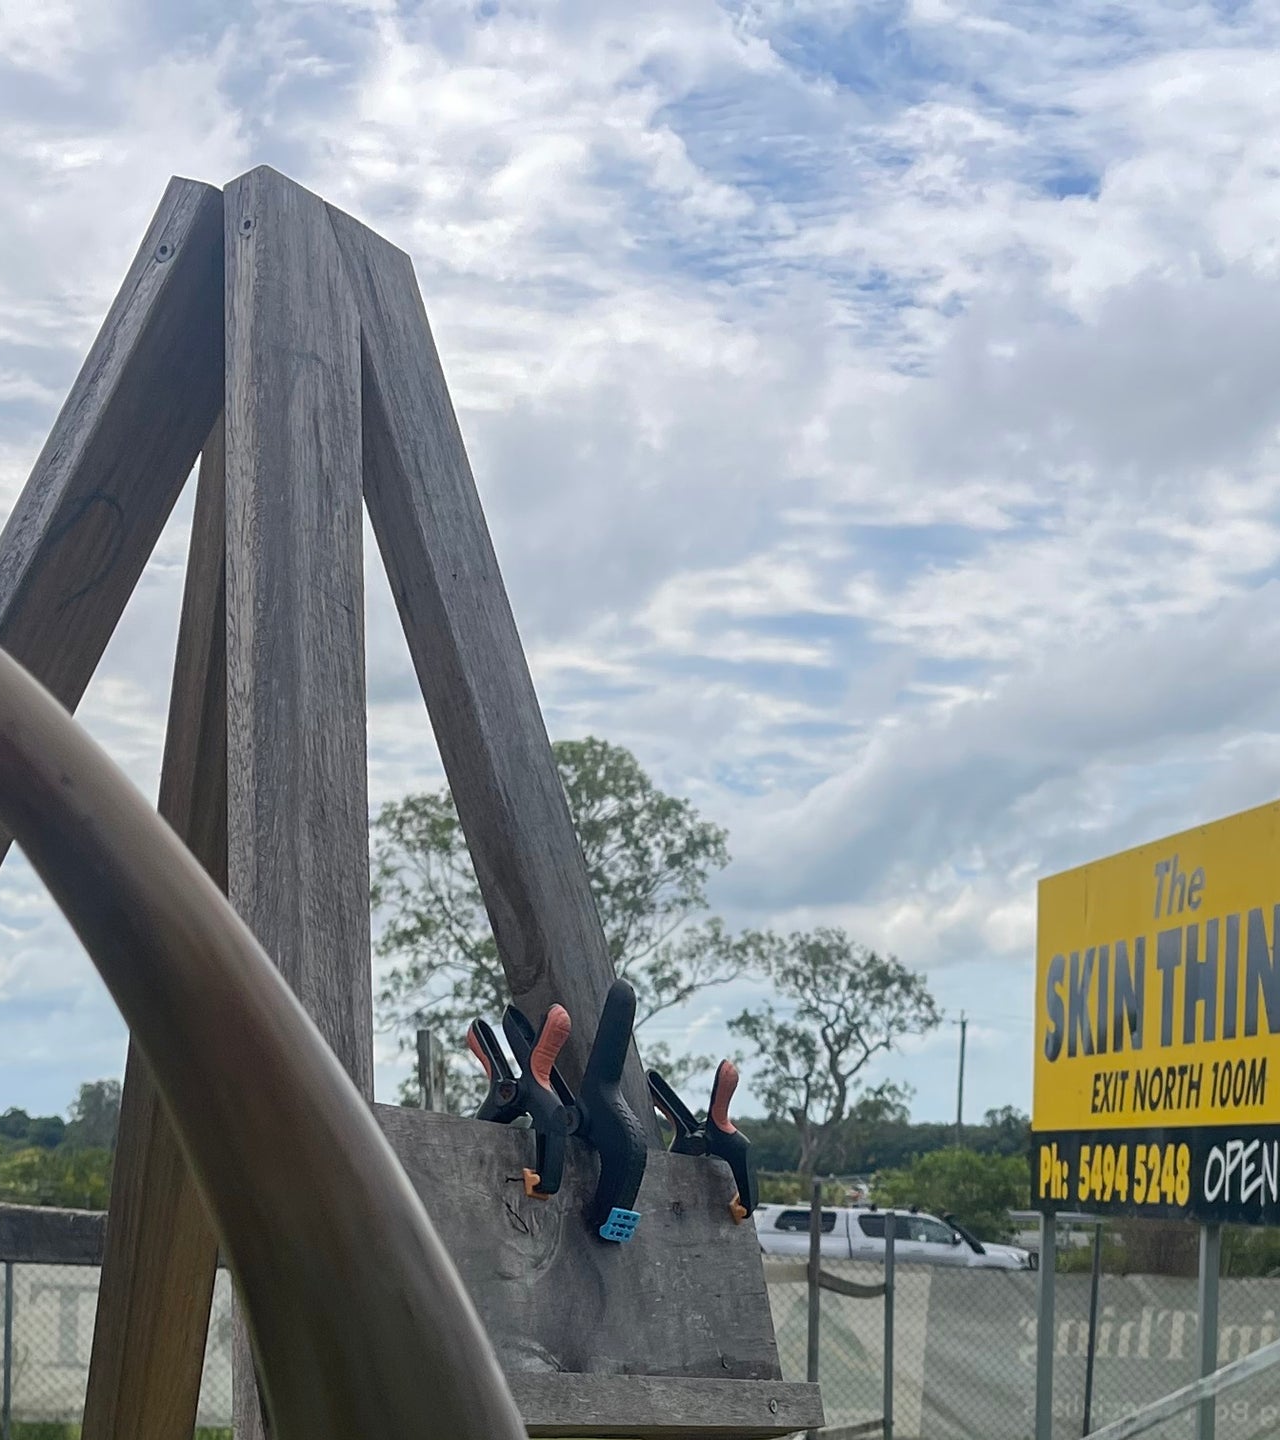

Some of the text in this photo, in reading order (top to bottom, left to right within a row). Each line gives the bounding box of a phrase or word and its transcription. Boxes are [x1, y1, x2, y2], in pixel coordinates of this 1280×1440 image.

[1153, 854, 1206, 919] The
[1044, 936, 1146, 1063] SKIN
[1091, 1057, 1267, 1114] EXIT NORTH 100M
[1039, 1143, 1068, 1199] Ph:
[1078, 1143, 1128, 1202] 5494
[1133, 1143, 1190, 1206] 5248
[1203, 1137, 1279, 1206] OPEN
